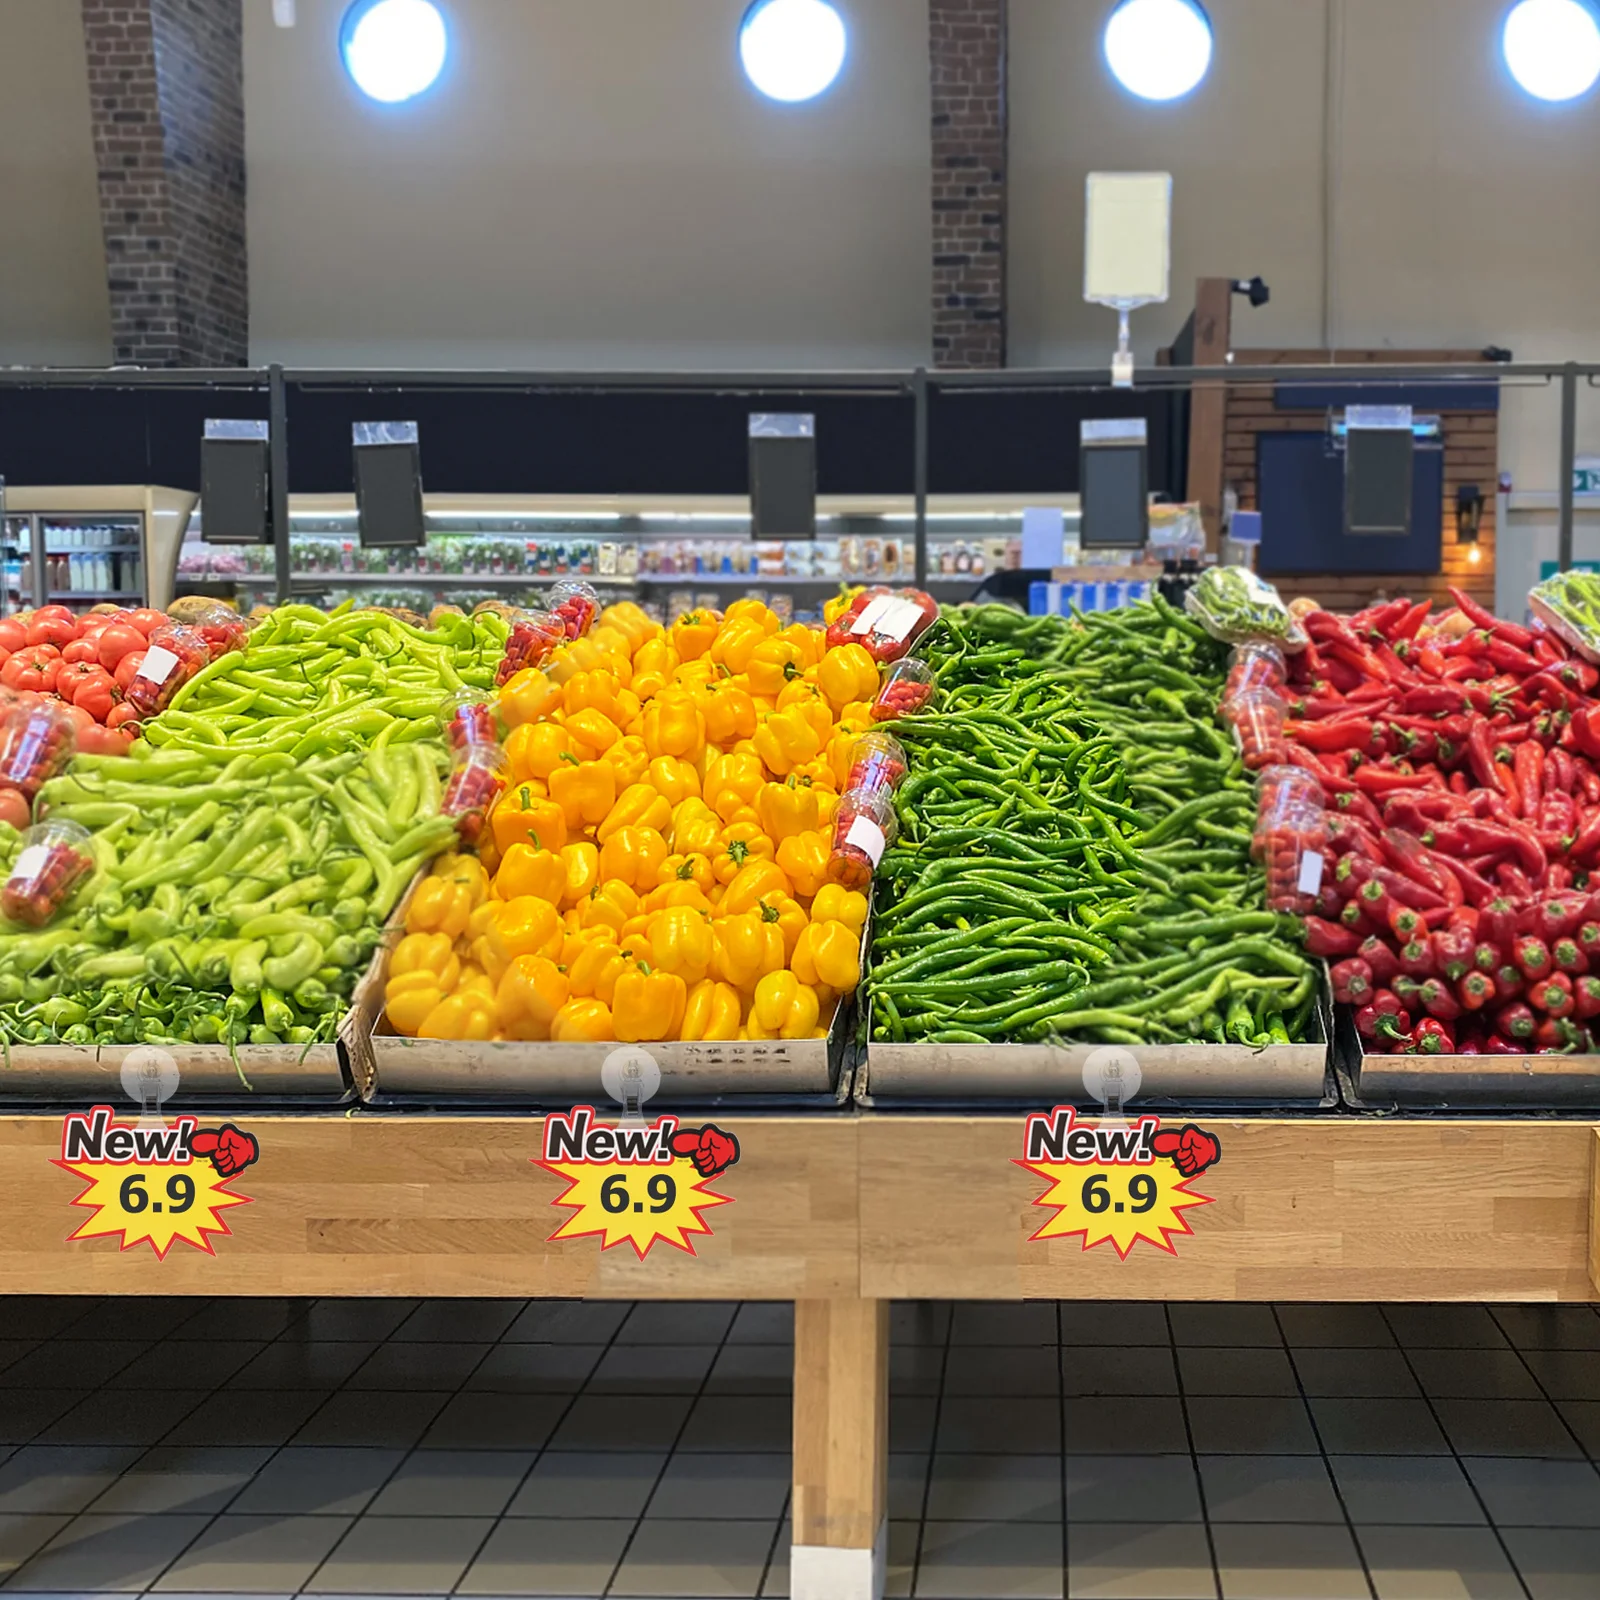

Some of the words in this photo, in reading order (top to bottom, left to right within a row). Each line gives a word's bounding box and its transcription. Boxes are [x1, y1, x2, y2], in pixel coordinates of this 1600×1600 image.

[67, 1112, 193, 1159] New!
[548, 1112, 674, 1159] New!
[1029, 1112, 1155, 1159] New!
[119, 1173, 196, 1214] 6.9
[600, 1173, 677, 1214] 6.9
[1081, 1173, 1158, 1214] 6.9
